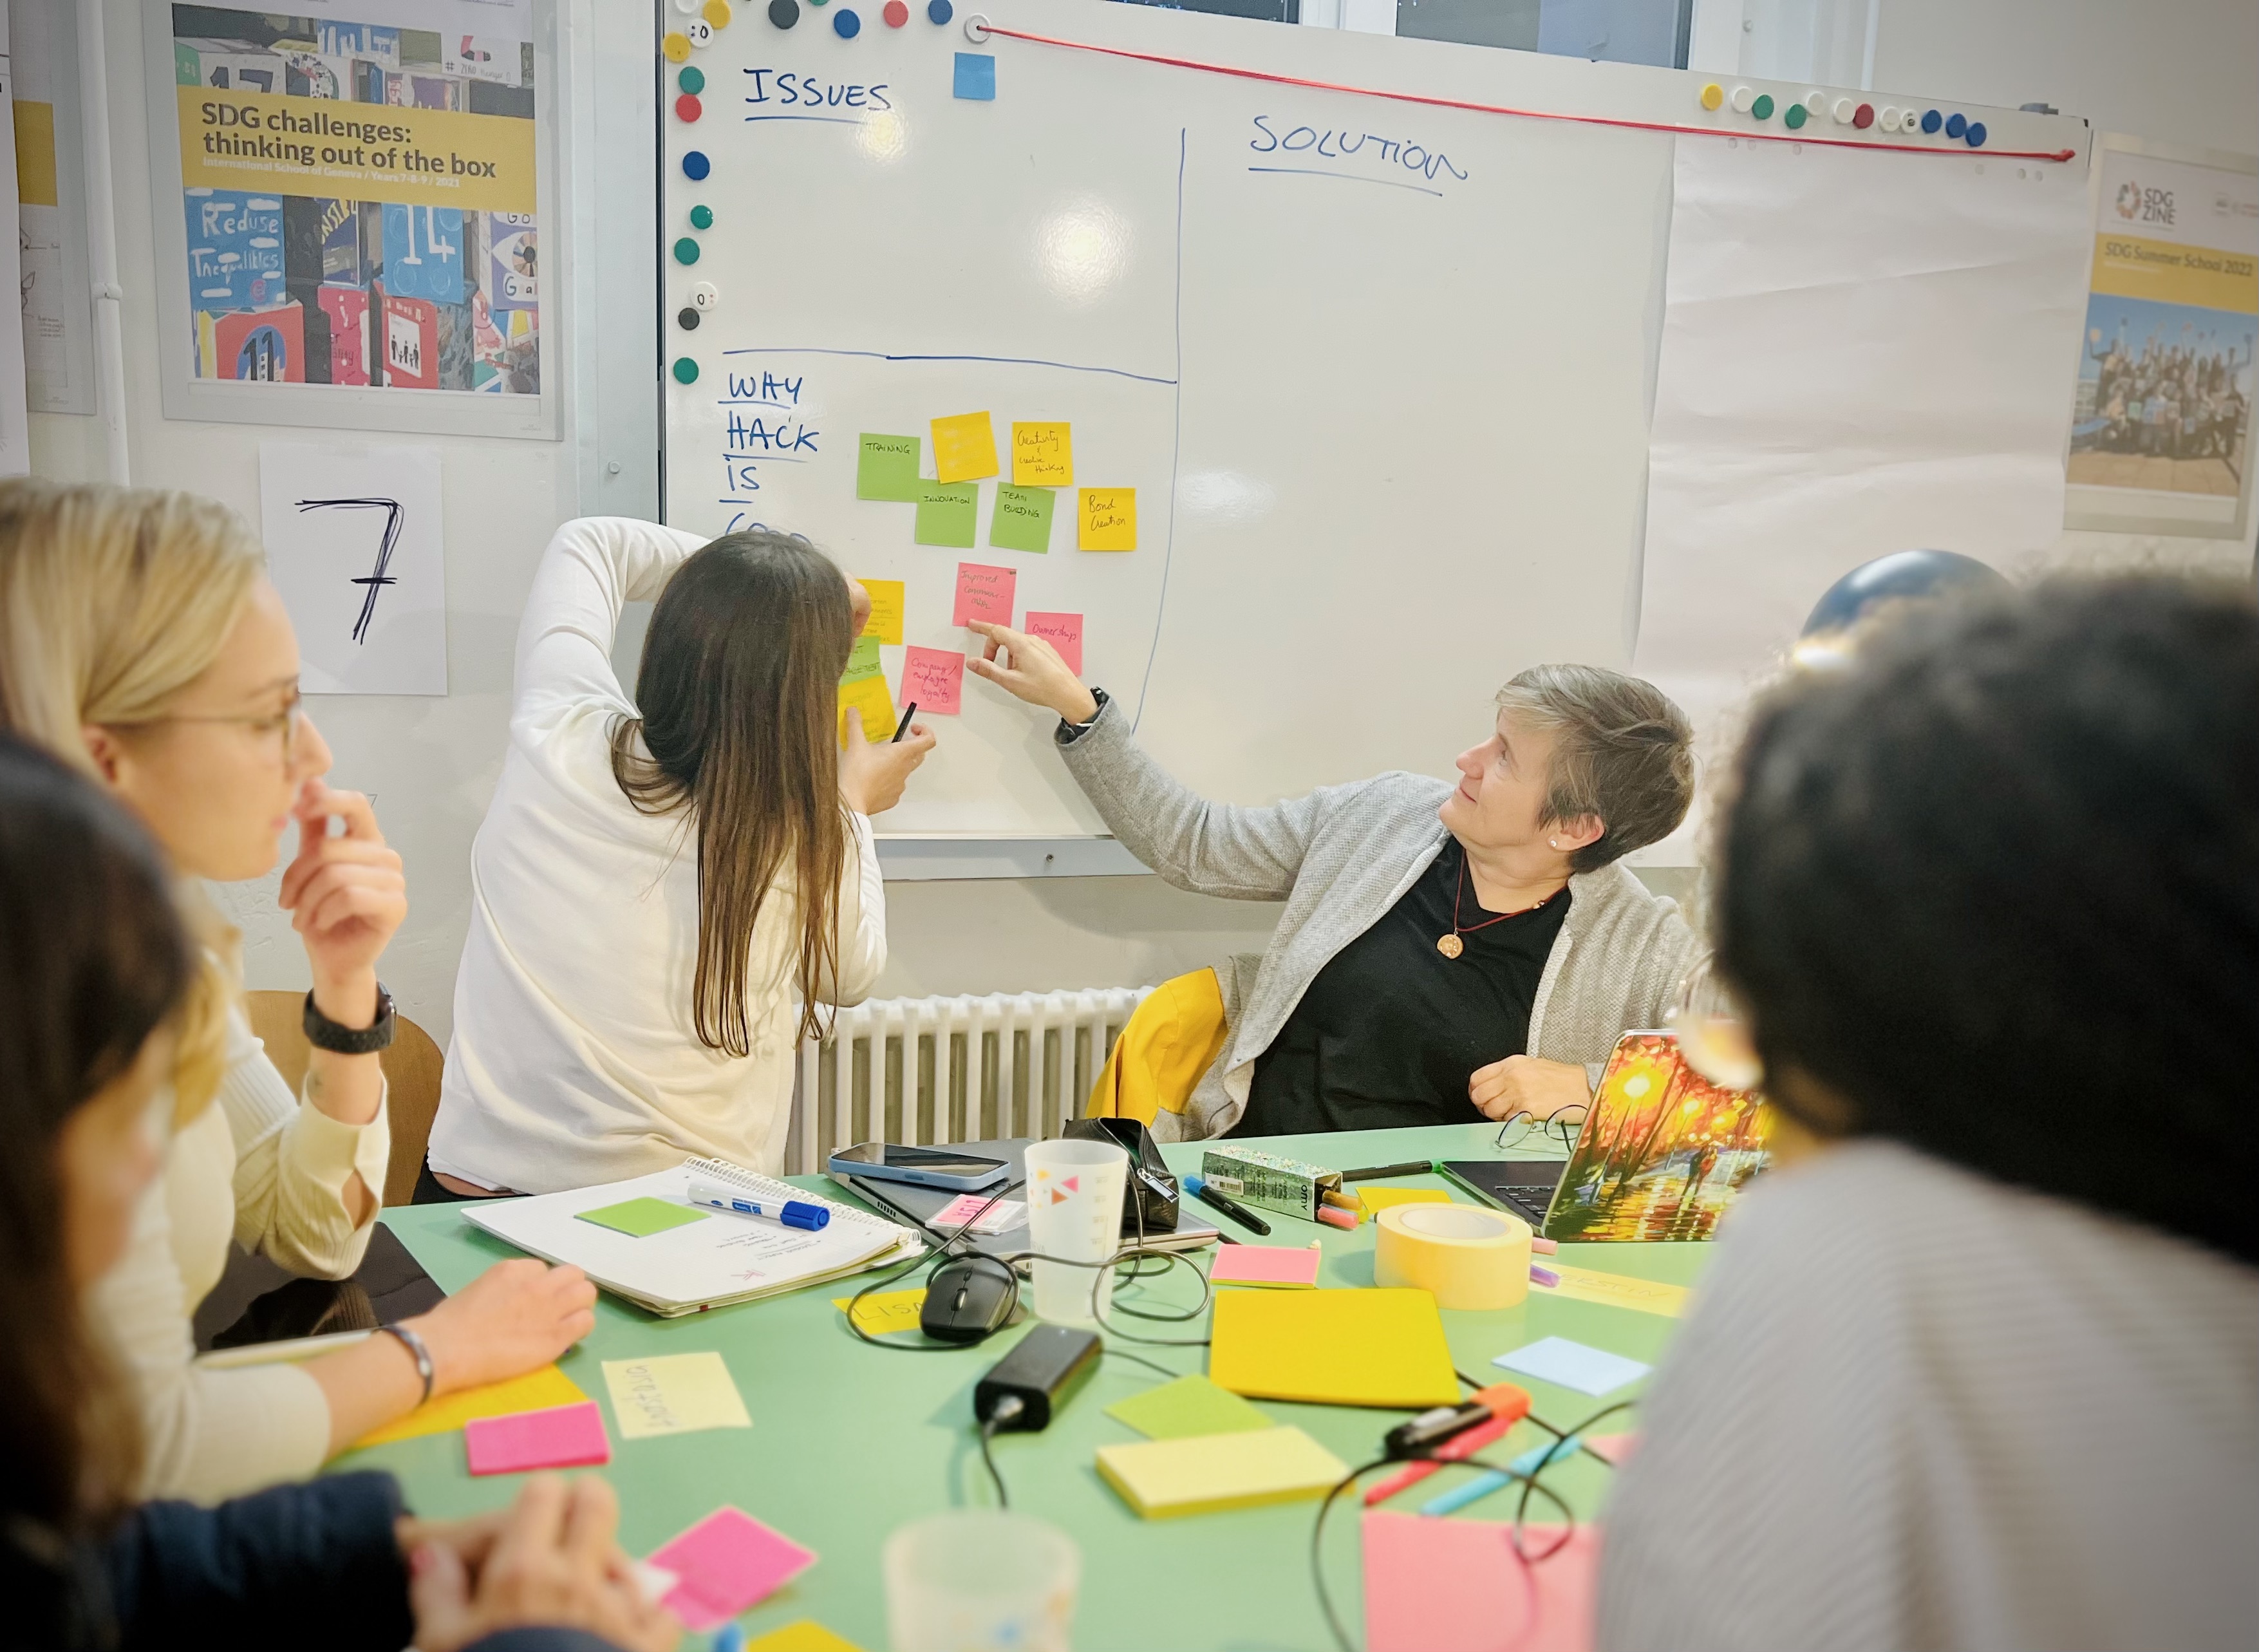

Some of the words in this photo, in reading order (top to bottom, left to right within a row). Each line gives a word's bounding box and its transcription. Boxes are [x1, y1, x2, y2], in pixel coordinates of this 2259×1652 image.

[744, 68, 891, 111] ISSUES
[202, 102, 261, 129] SDG
[268, 109, 412, 144] challenges:
[203, 132, 315, 166] thinking
[322, 146, 365, 167] out
[372, 147, 397, 169] of
[403, 150, 445, 173] the
[452, 153, 496, 178] box
[203, 156, 272, 171] International
[275, 162, 309, 174] School
[1250, 115, 1468, 180] SOLUTION
[2142, 205, 2176, 225] ZINE
[2144, 187, 2174, 207] SDG
[2105, 242, 2132, 259] SDG
[2133, 245, 2181, 265] Summer
[2184, 254, 2222, 272] School
[729, 371, 802, 404] WHY
[727, 410, 820, 452] HACK
[294, 498, 404, 646] 7
